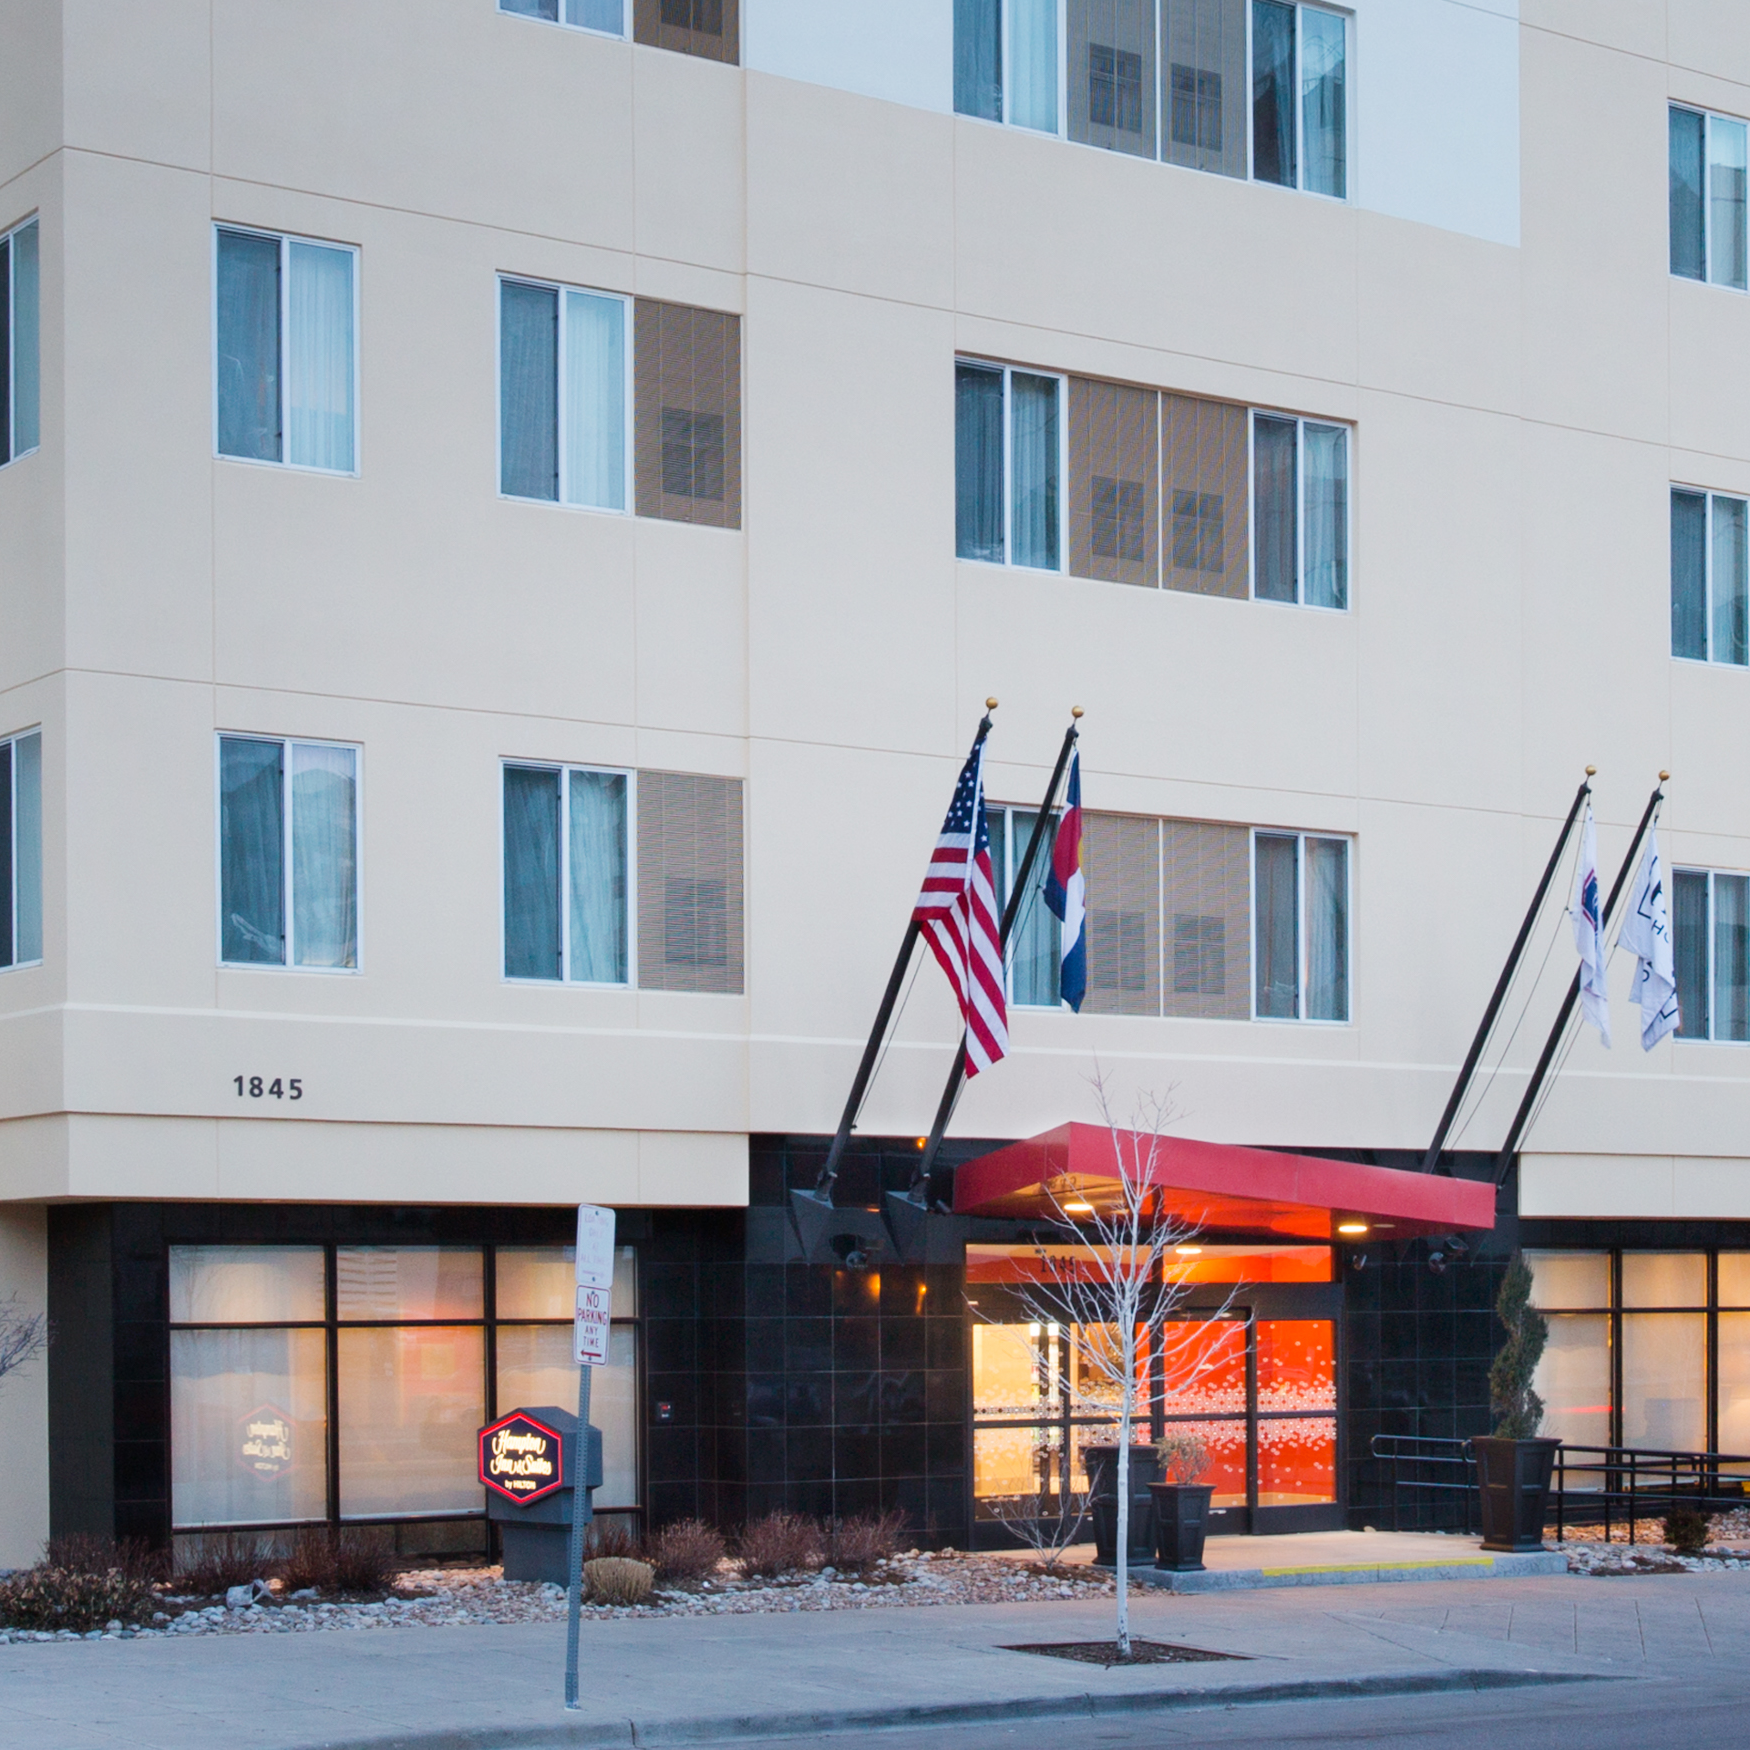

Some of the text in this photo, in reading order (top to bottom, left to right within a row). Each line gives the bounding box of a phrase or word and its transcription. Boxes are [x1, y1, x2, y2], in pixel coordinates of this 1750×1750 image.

[233, 1075, 303, 1100] 1845
[586, 1293, 600, 1308] NO
[578, 1308, 607, 1326] PARKING
[585, 1325, 598, 1335] ANY
[583, 1336, 599, 1348] TIME
[492, 1429, 546, 1455] Hampton
[490, 1453, 517, 1475] Inn
[522, 1454, 552, 1476] Suites
[504, 1479, 536, 1490] by HILTON
